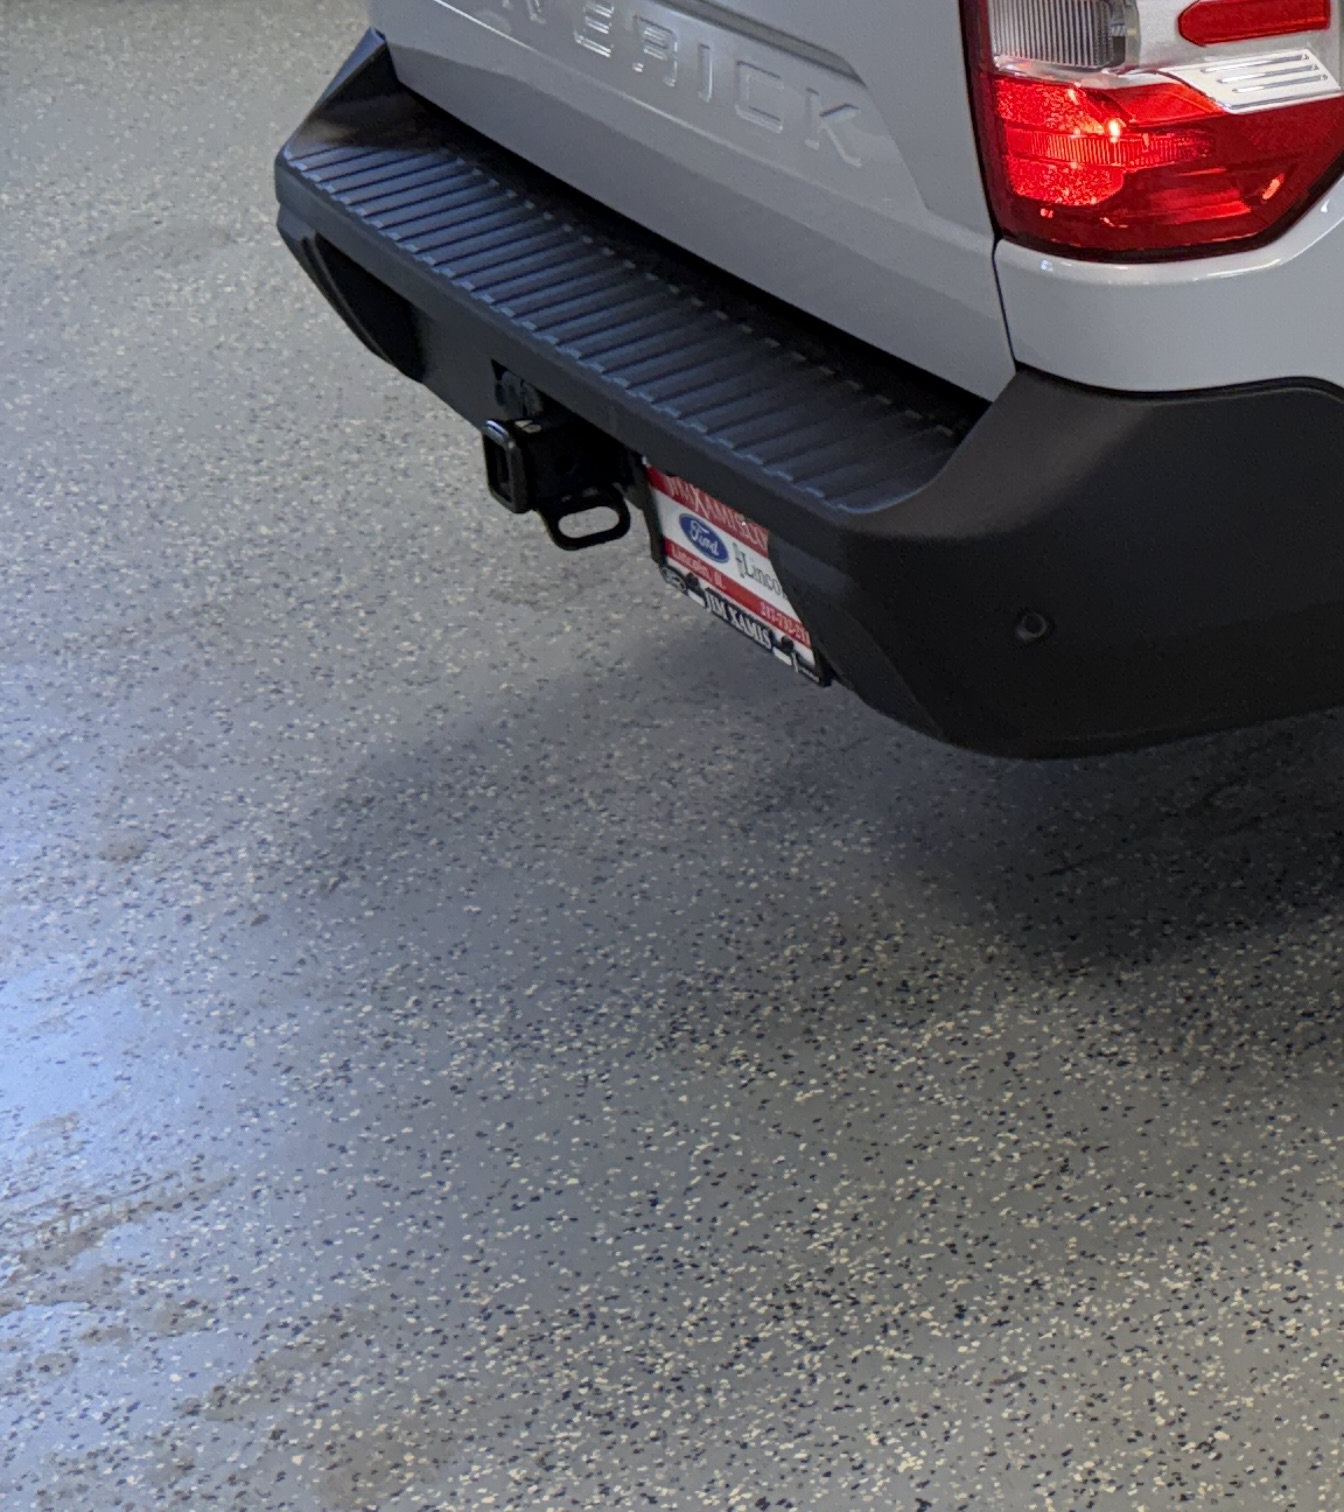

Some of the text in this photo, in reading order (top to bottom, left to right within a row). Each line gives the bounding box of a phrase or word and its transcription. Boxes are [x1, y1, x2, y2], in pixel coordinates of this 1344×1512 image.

[690, 519, 719, 557] Ford
[705, 590, 772, 651] JIM XAMIS
